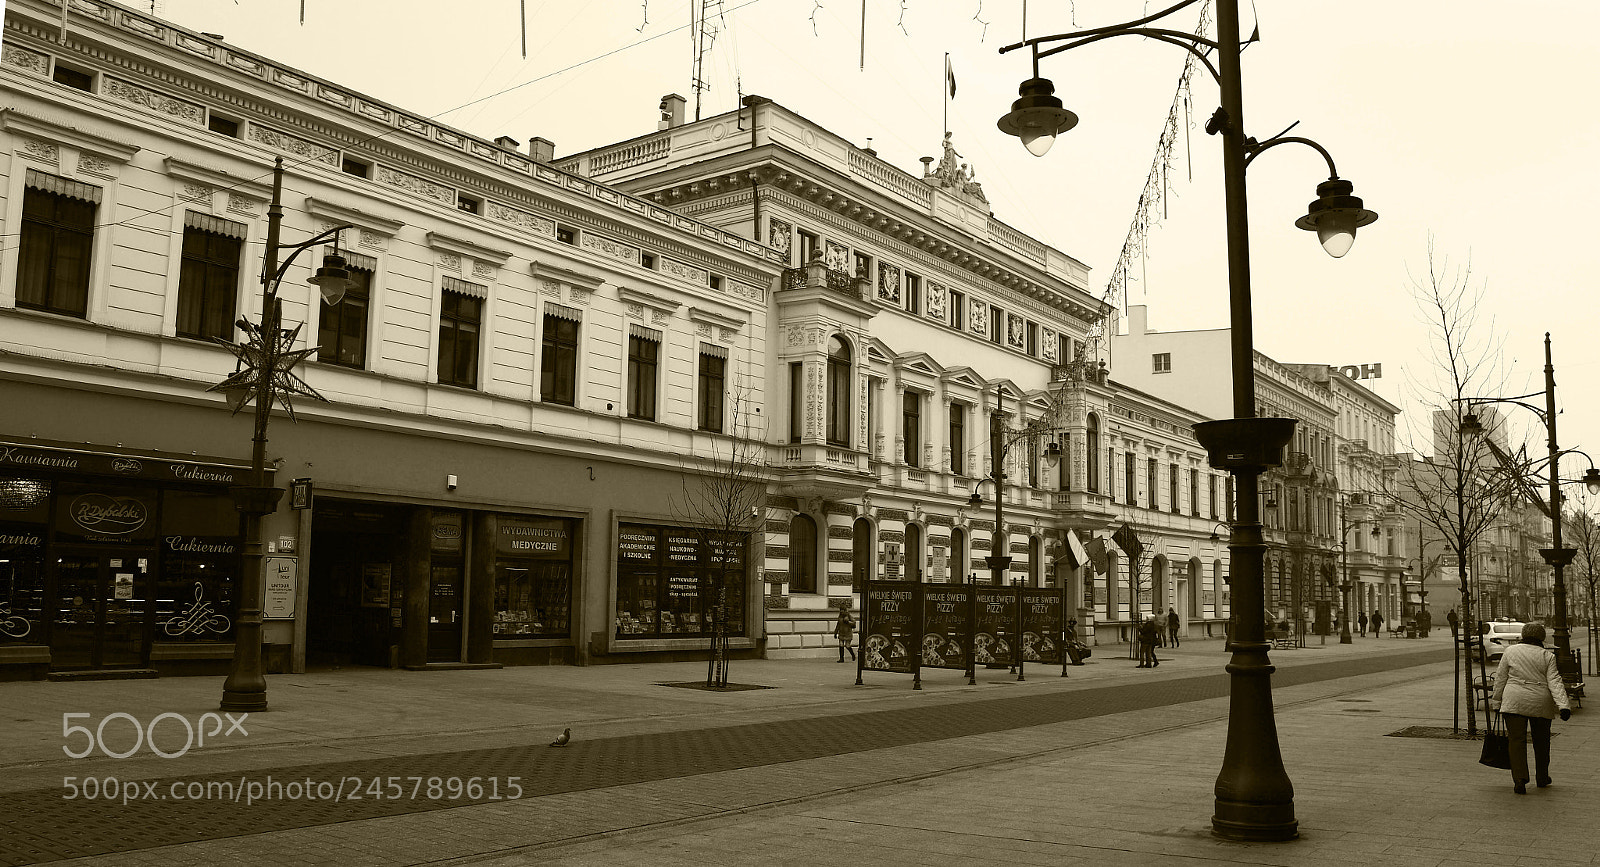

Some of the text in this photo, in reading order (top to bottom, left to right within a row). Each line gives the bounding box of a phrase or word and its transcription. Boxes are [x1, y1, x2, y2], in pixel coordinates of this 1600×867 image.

[0, 446, 78, 469] Kawiarnia
[170, 464, 234, 482] Cukiernia
[502, 526, 567, 539] WYDAWNICTWA
[619, 534, 656, 542] PODRĘCZNIKI
[668, 537, 699, 545] KSIĘGARNIA
[166, 536, 236, 553] Cukiernia
[281, 540, 292, 549] 102
[511, 540, 558, 551] MEDYCZNE
[619, 543, 656, 551] AKADEMICKIE
[627, 552, 652, 560] SZKOLNE
[870, 590, 912, 602] WIELKIE ŚWIĘTO
[926, 592, 967, 603] WIELKIE ŚWIĘTO
[881, 601, 900, 612] PIZZY
[937, 603, 955, 613] PIZZY
[986, 605, 1004, 613] PIZZY
[1032, 605, 1048, 614] PIZZY
